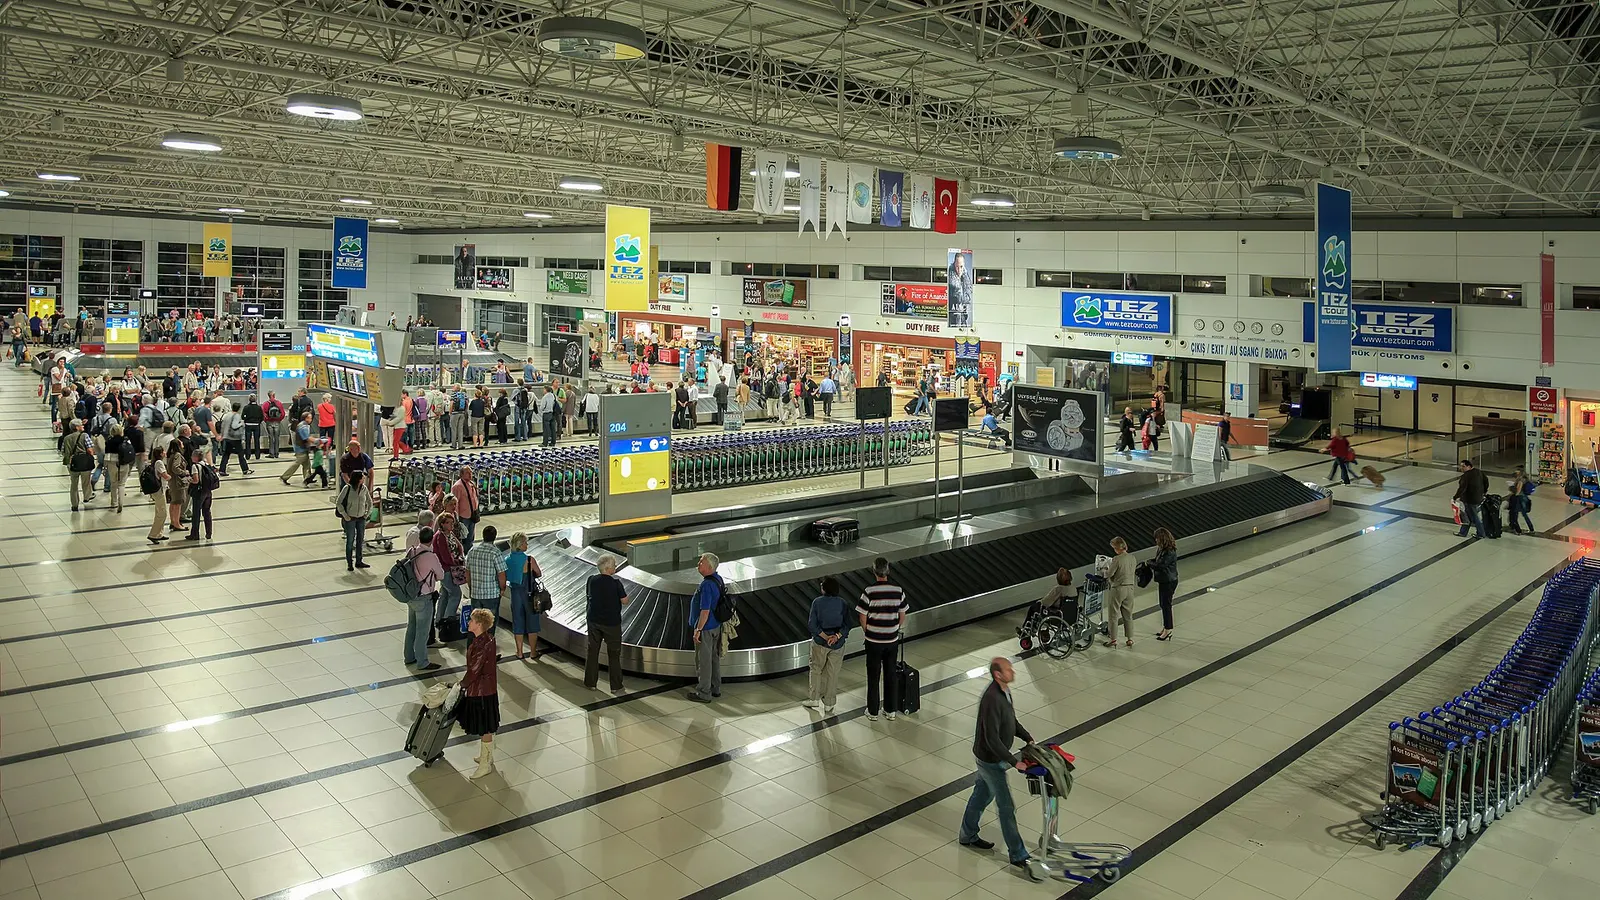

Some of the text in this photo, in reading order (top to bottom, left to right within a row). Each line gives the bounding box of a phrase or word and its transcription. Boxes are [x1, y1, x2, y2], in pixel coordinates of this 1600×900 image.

[610, 266, 644, 274] TEZ
[1321, 292, 1348, 306] TEZ
[1104, 299, 1158, 313] TEZ
[1324, 307, 1346, 315] tour
[1109, 312, 1153, 320] tour
[1360, 311, 1435, 327] TEZ
[906, 323, 940, 332] DUTY FREE
[1105, 321, 1158, 329] www.teztour.com
[1367, 326, 1427, 335] tour
[1362, 336, 1435, 346] www.teztour.com
[1191, 343, 1206, 356] ÇIKIŞ
[1211, 344, 1224, 354] EXIT
[1380, 352, 1425, 360] CUSTOMS
[609, 422, 627, 433] 204
[1410, 752, 1421, 761] talk
[1420, 756, 1437, 767] about!
